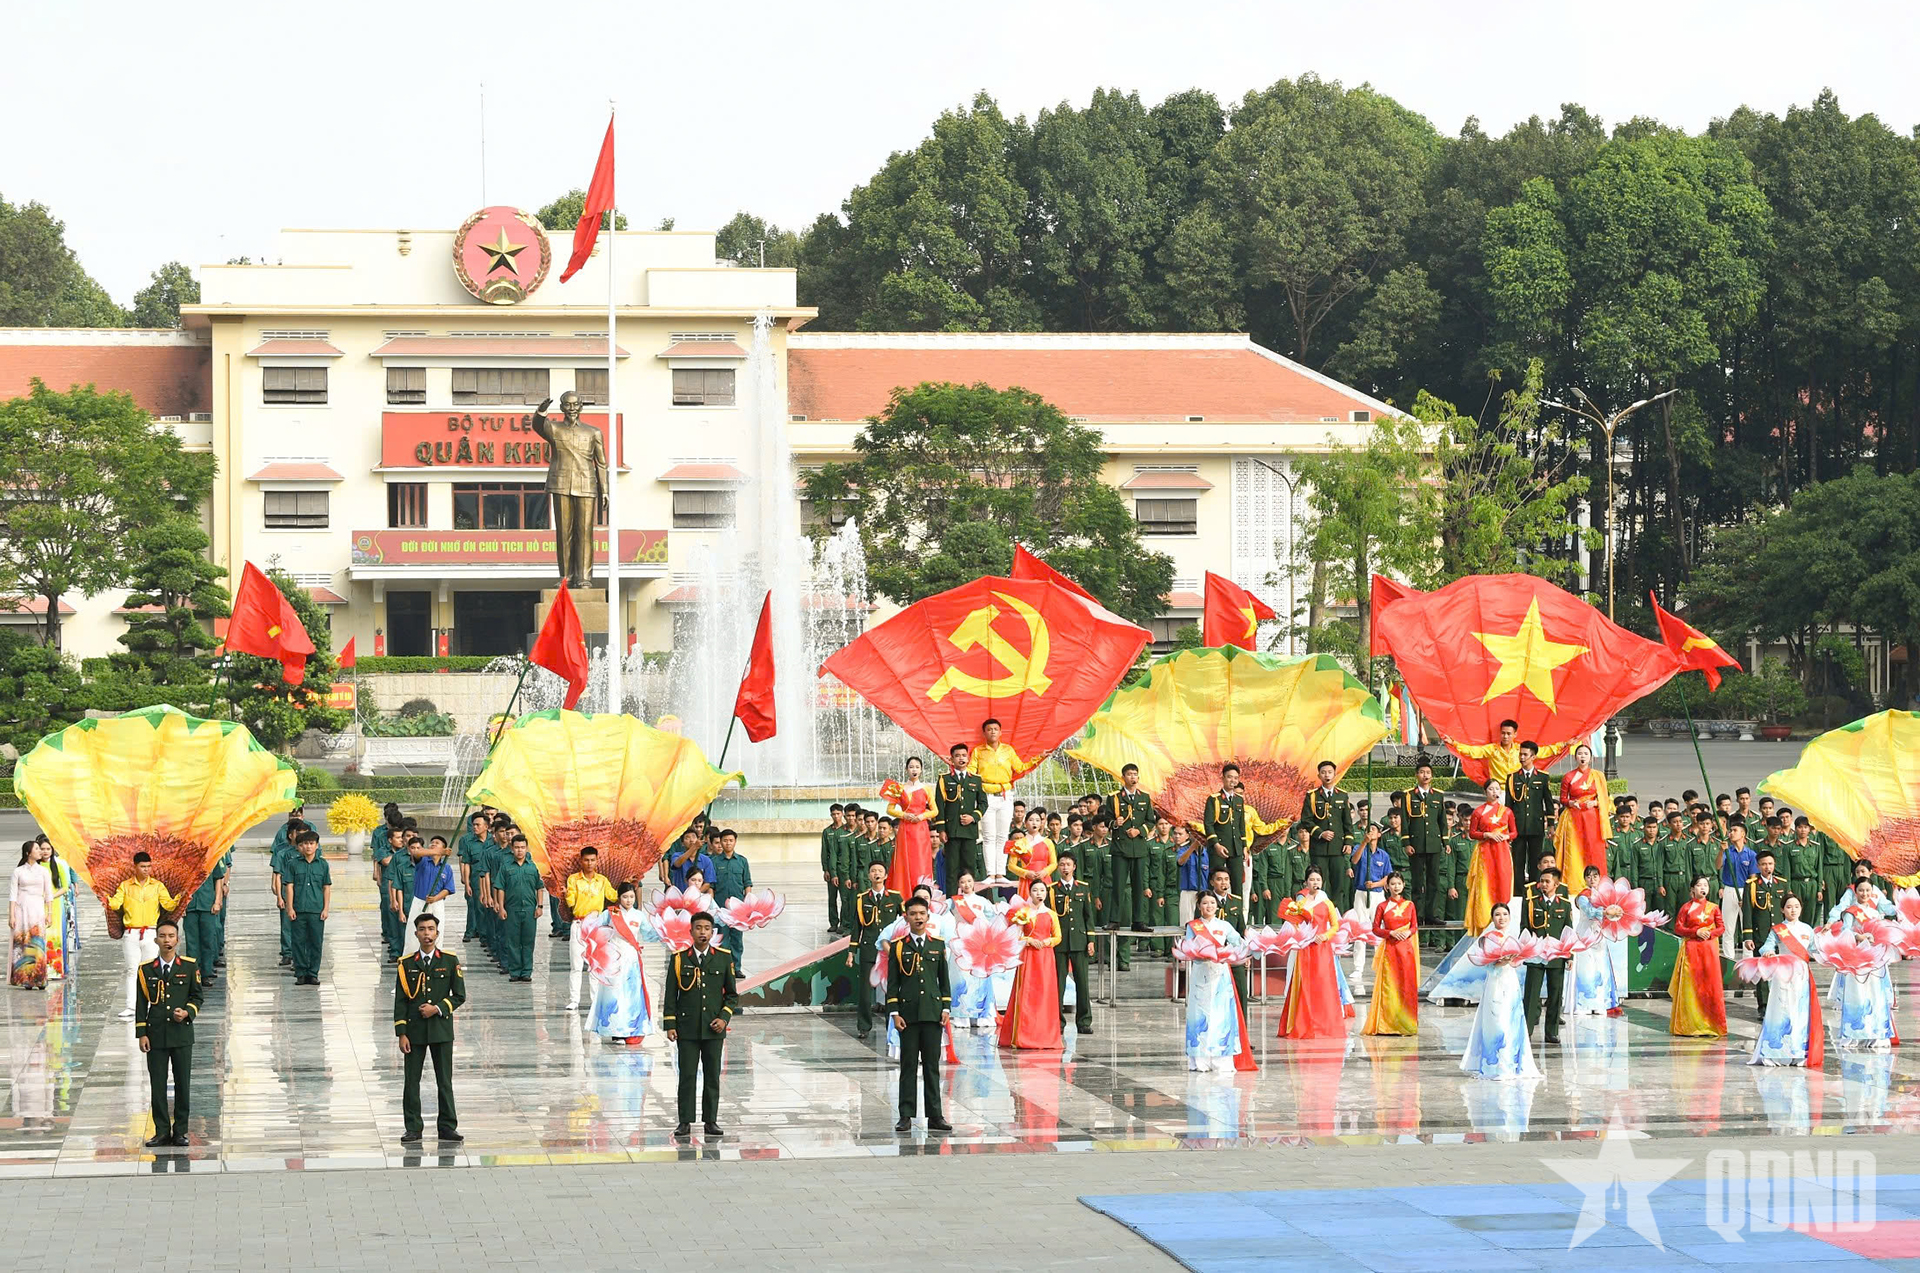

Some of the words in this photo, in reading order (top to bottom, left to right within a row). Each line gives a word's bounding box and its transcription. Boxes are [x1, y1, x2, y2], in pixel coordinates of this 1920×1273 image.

[447, 414, 474, 434] BỘ
[479, 416, 504, 431] TƯ
[415, 436, 494, 466] QUÂN
[440, 539, 461, 552] NHỚ
[463, 540, 476, 552] ƠN
[479, 538, 498, 552] CHỦ
[501, 541, 523, 554] TỊCH
[526, 537, 540, 552] HỒ
